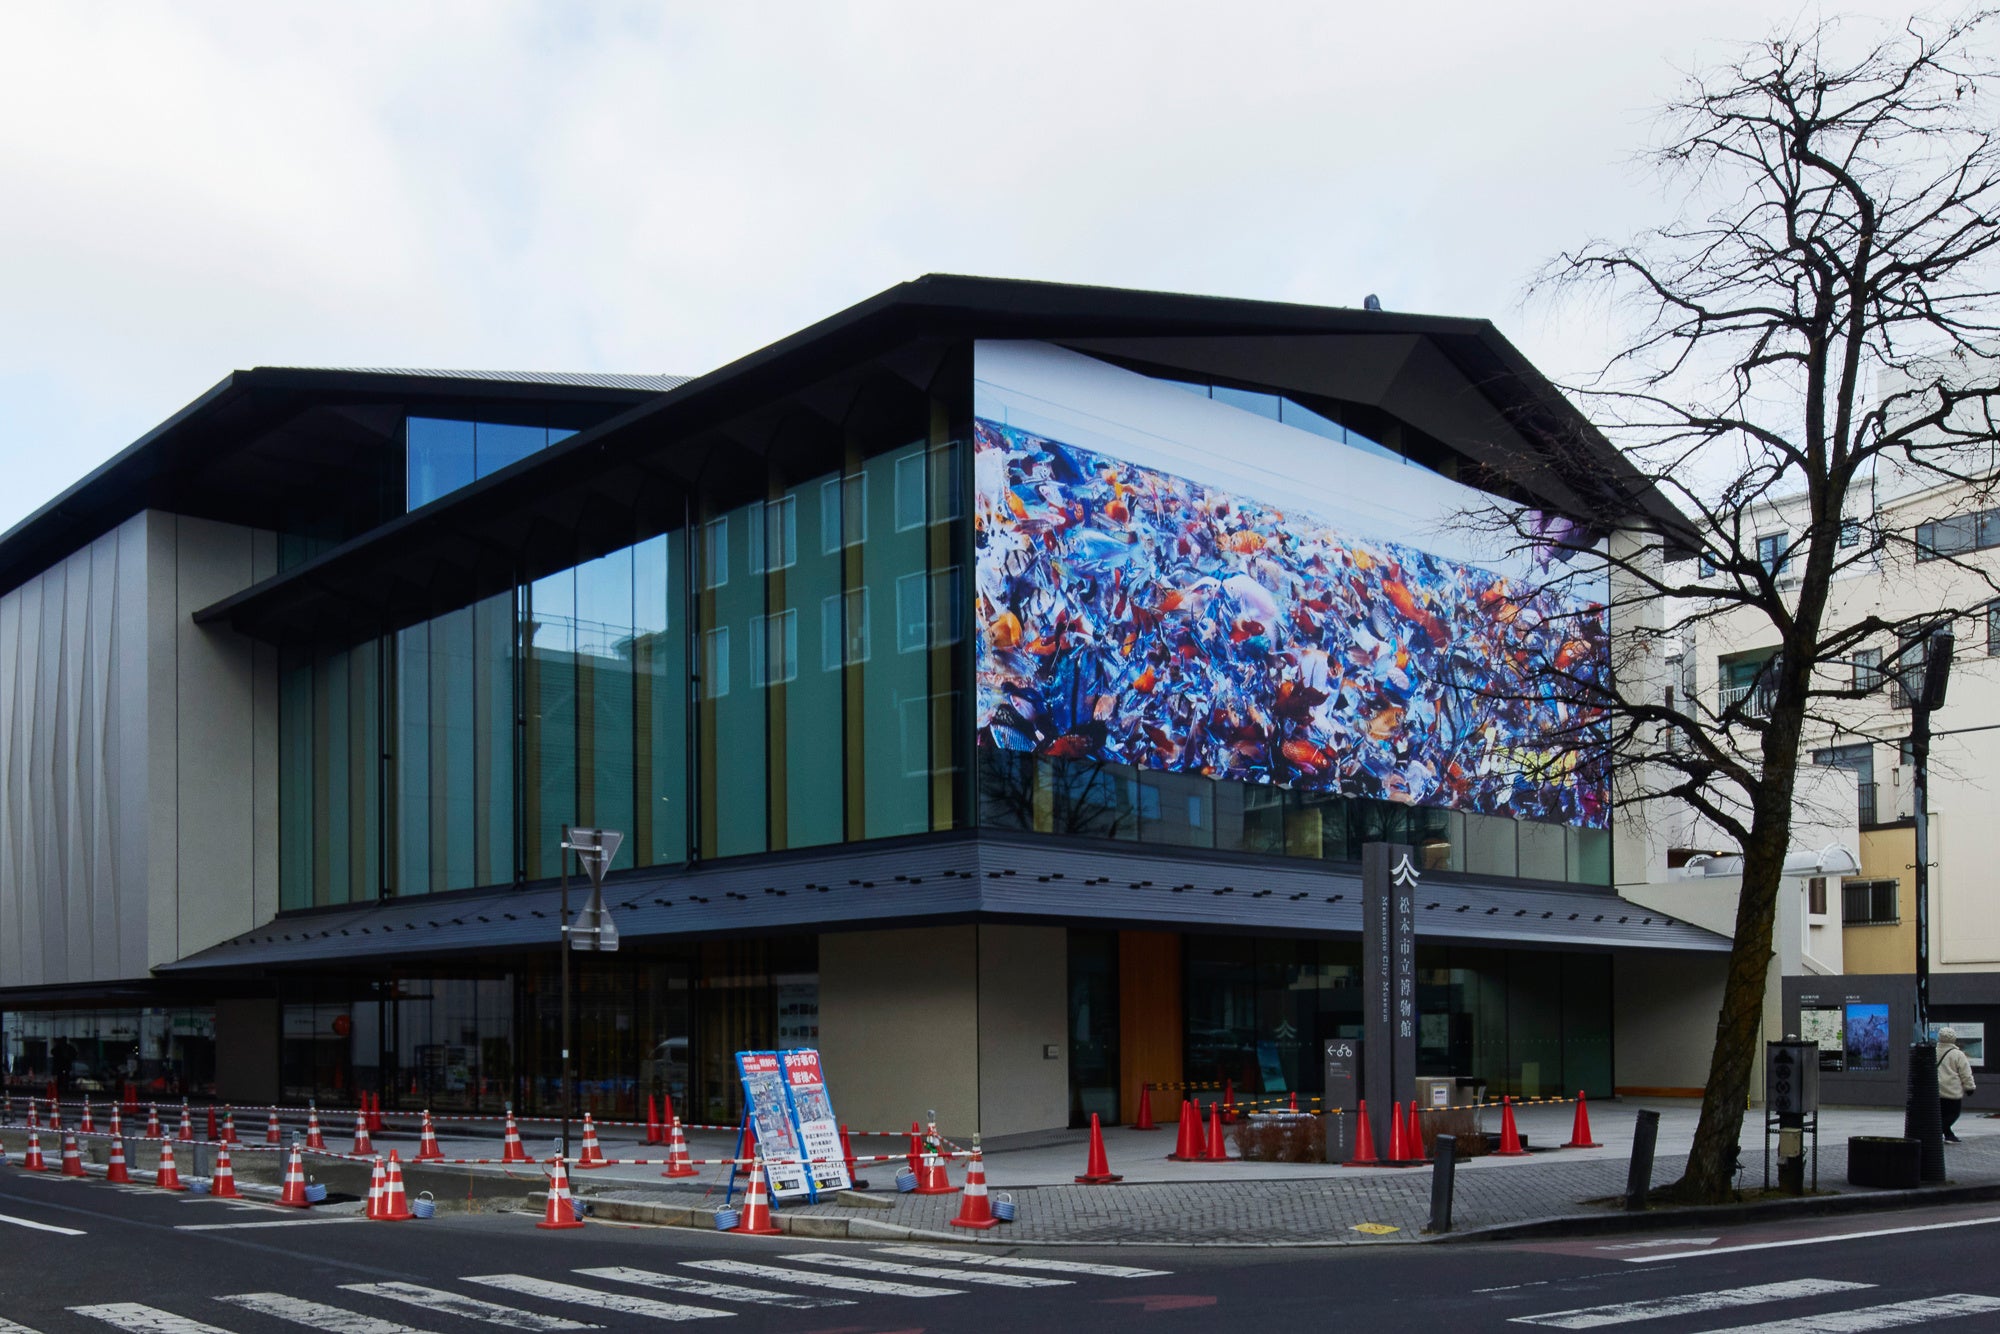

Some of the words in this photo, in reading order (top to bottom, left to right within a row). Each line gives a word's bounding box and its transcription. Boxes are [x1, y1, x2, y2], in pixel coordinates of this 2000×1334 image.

[1381, 955, 1389, 977] City
[1399, 896, 1412, 1038] 松本市立博物館
[784, 1054, 817, 1067] 歩行者の
[792, 1071, 818, 1083] 皆様へ
